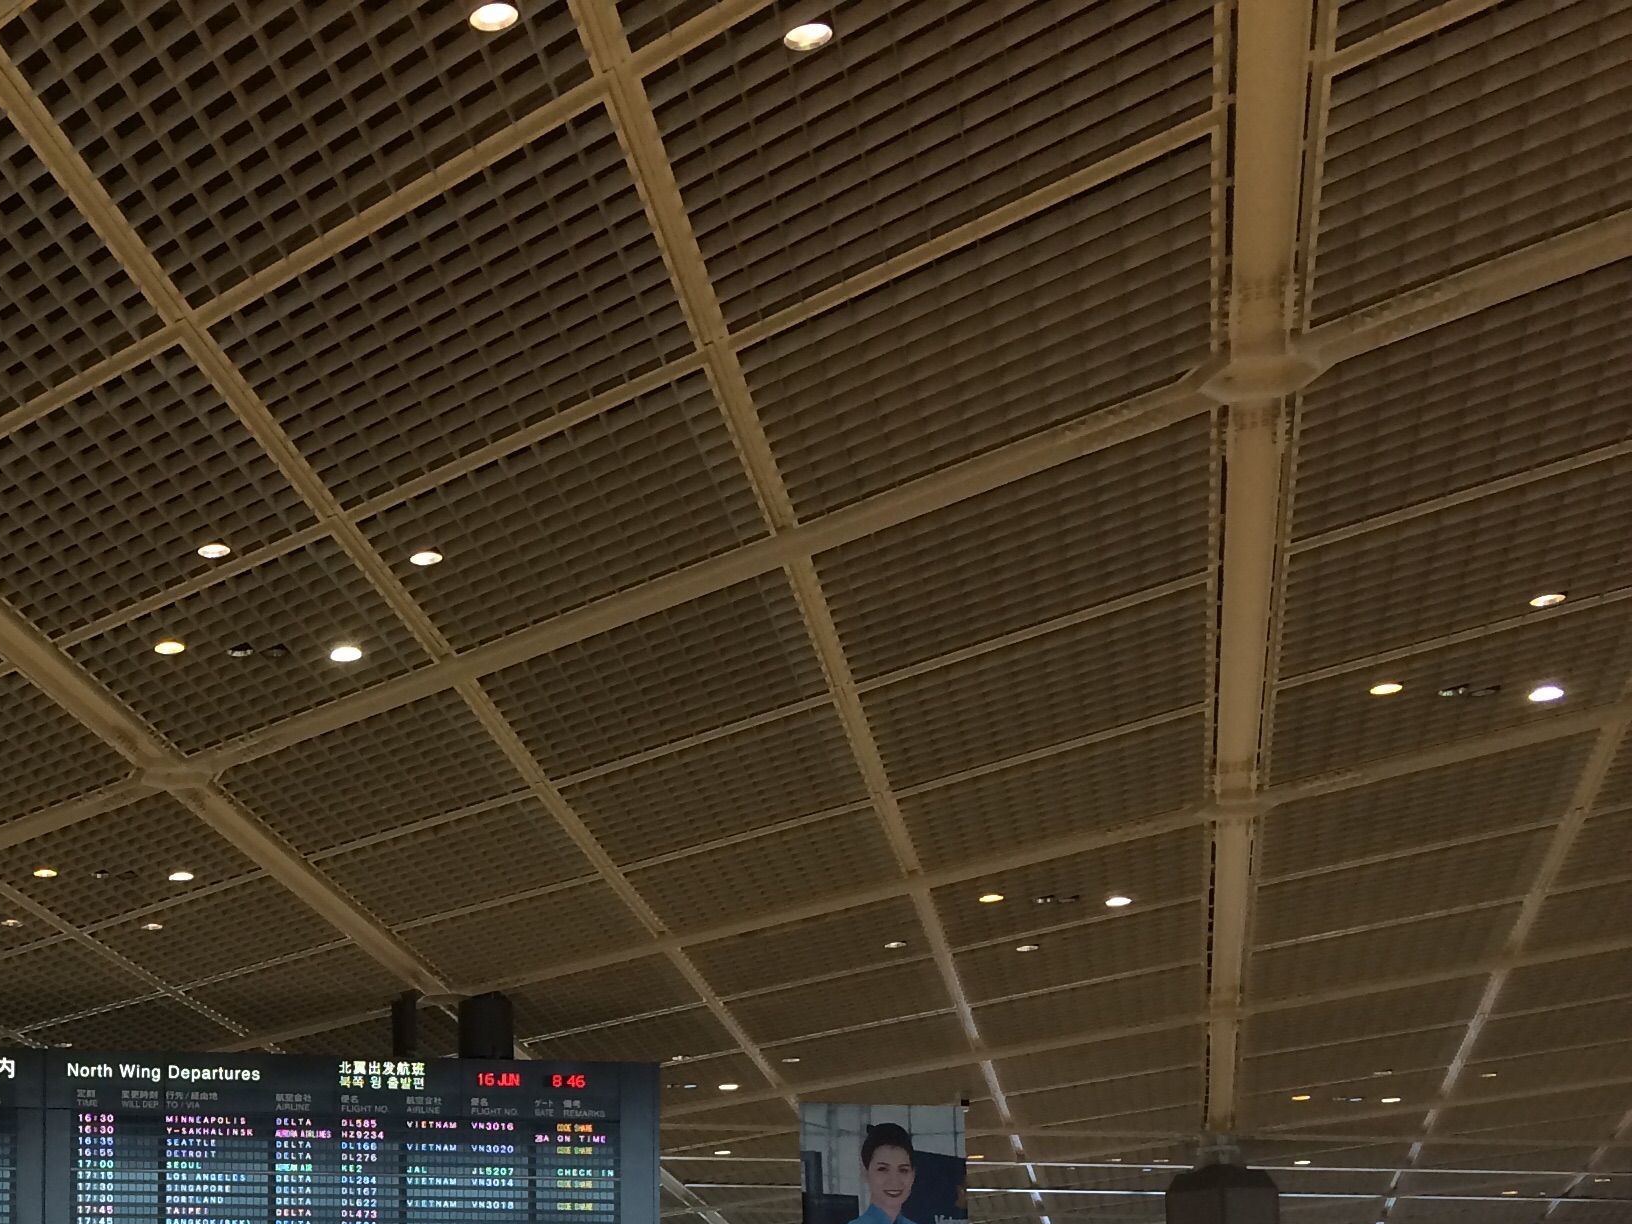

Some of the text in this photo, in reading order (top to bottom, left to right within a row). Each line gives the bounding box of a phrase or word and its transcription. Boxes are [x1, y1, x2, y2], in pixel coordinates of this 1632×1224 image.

[67, 1063, 260, 1082] North Wing Departures
[477, 1073, 494, 1086] 16
[497, 1073, 520, 1087] JUN
[78, 1114, 457, 1129] 16:30 MINNEAPOLIS DELTA VIETNAM
[78, 1125, 606, 1143] 16:30 Y-SAKHALINSK ON TIME
[167, 1138, 216, 1147] SEATTLE
[166, 1150, 216, 1158] DETROIT
[77, 1159, 614, 1177] 17:00 SEOUL JAL CHECK IN
